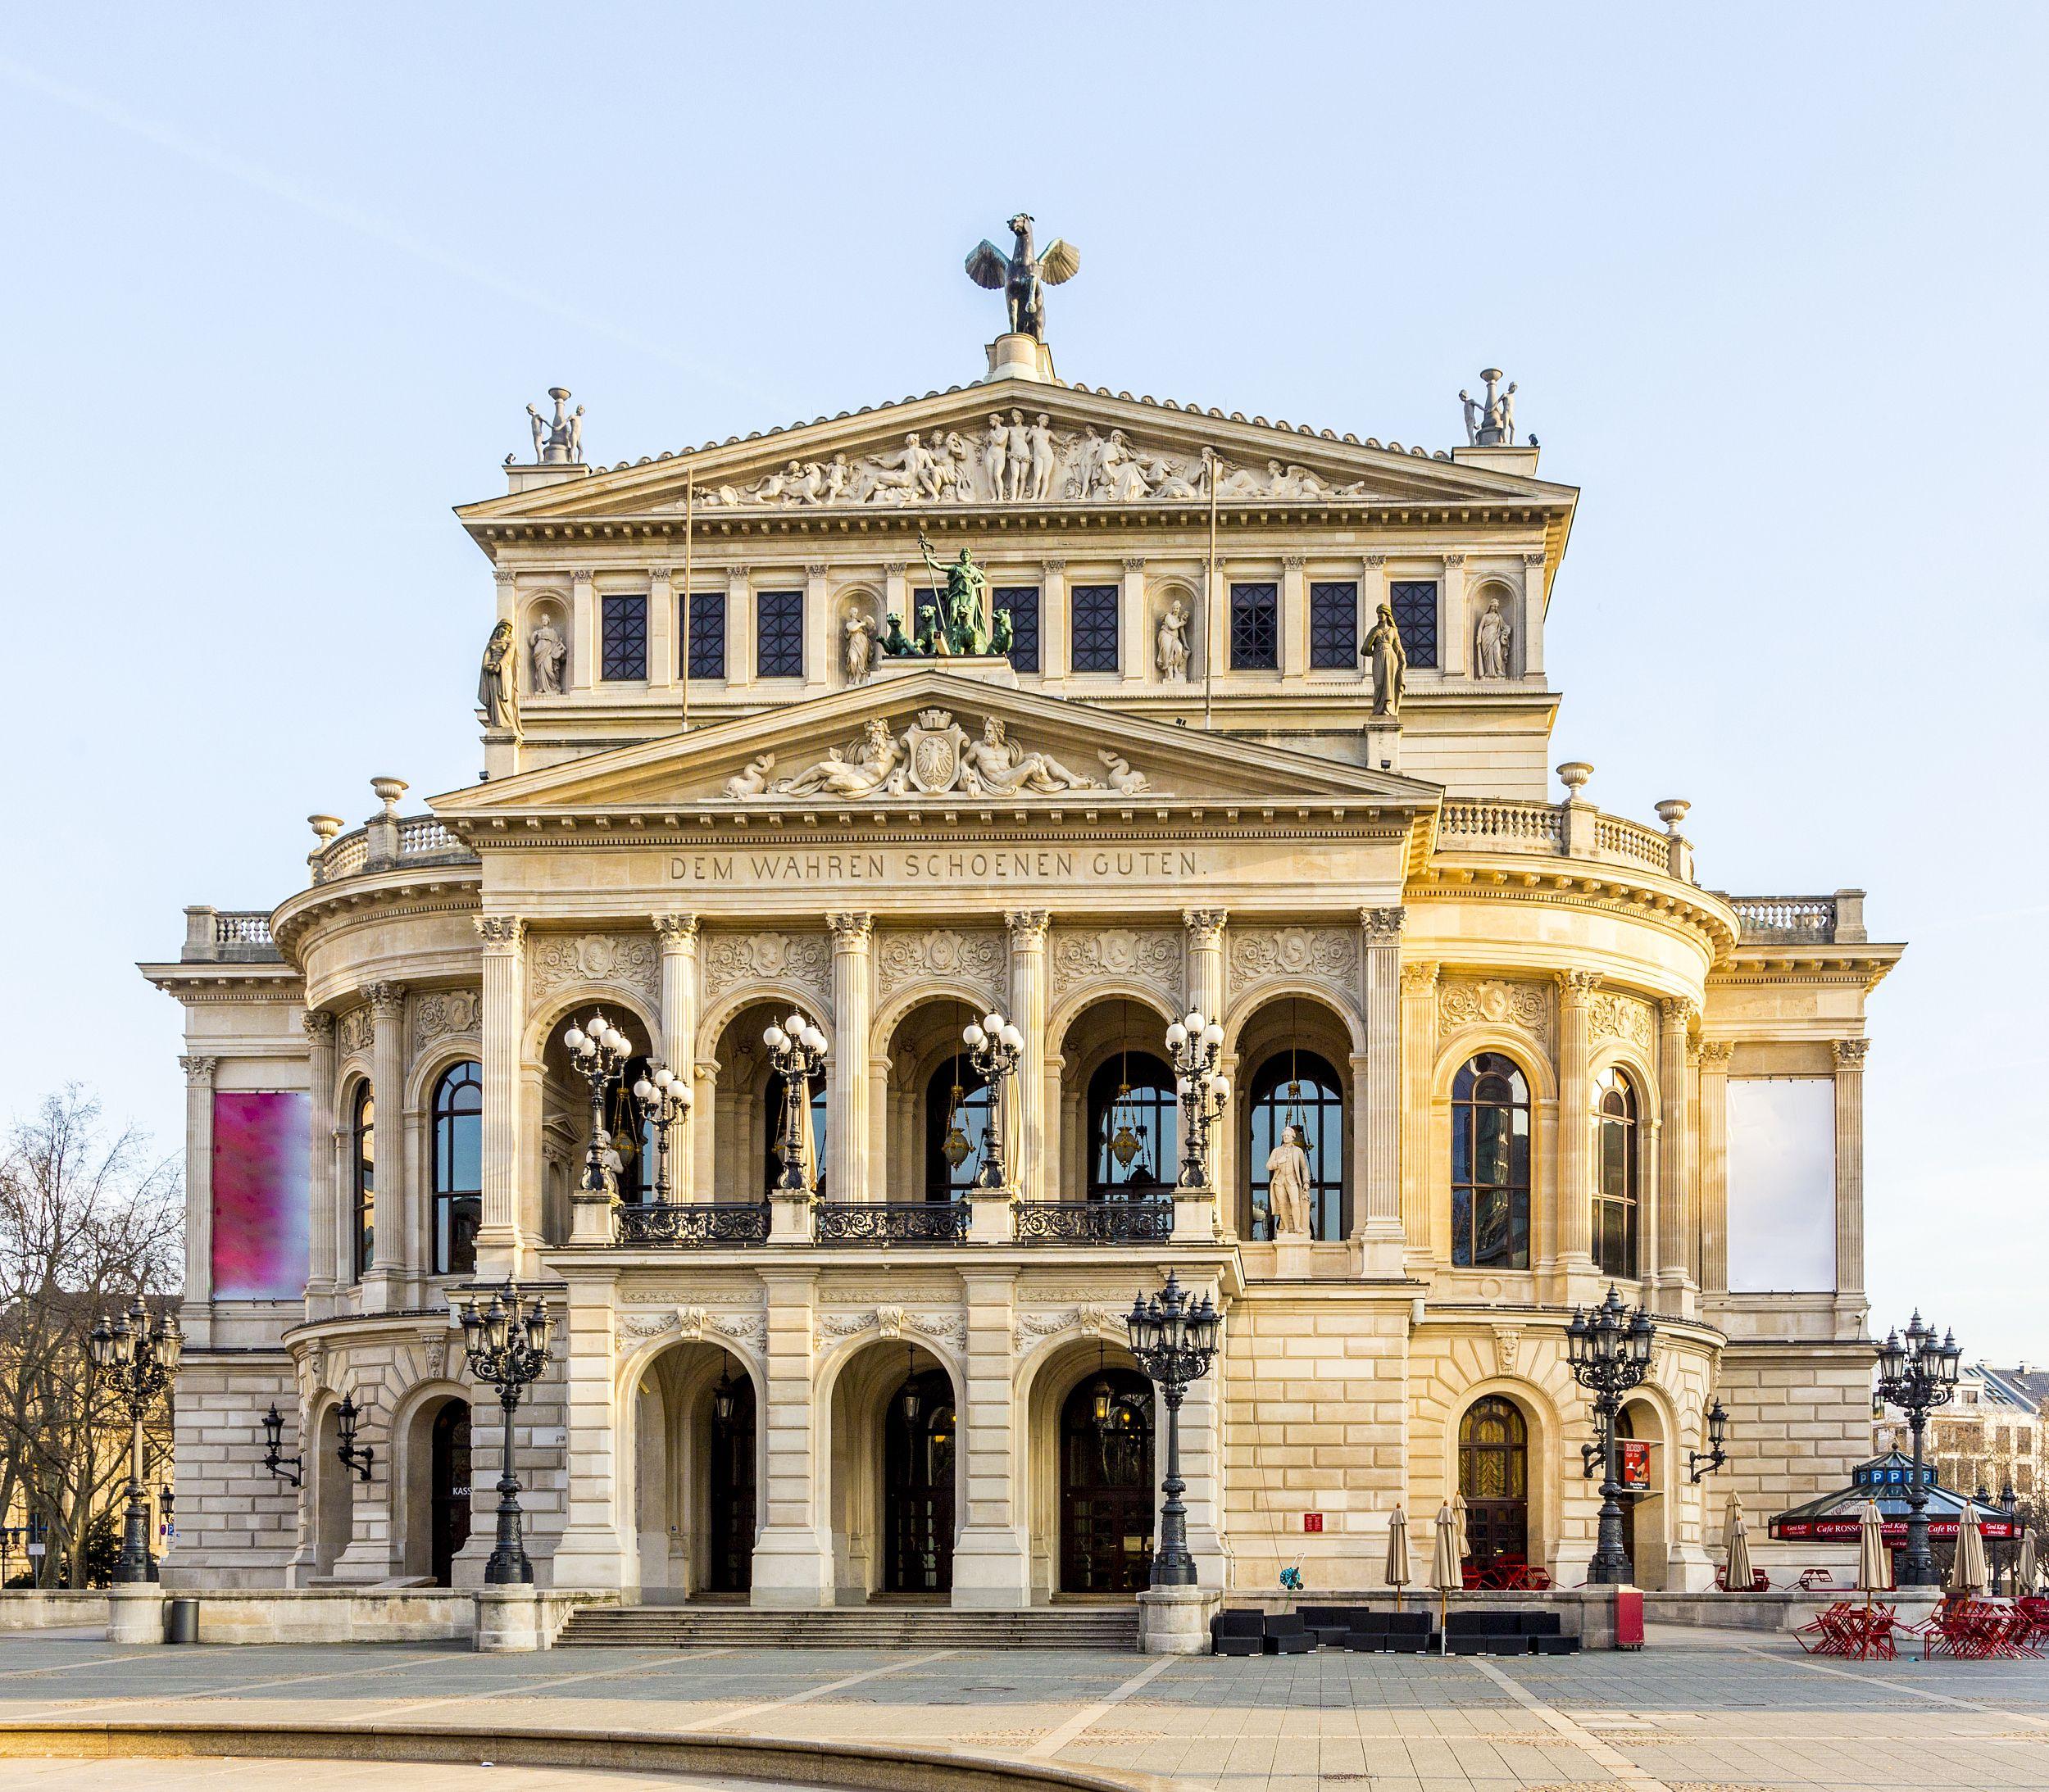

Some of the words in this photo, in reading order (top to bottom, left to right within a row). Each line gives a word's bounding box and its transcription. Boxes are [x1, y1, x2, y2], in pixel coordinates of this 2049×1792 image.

[670, 857, 733, 880] DEM
[751, 855, 884, 879] WAHREN
[905, 853, 1073, 877] SCHOENEN
[1093, 852, 1207, 876] GUTEN.
[1874, 1472, 1882, 1483] P
[1891, 1472, 1899, 1483] P
[1924, 1473, 1929, 1483] P
[1816, 1525, 1833, 1534] Café
[1927, 1525, 1945, 1534] Café
